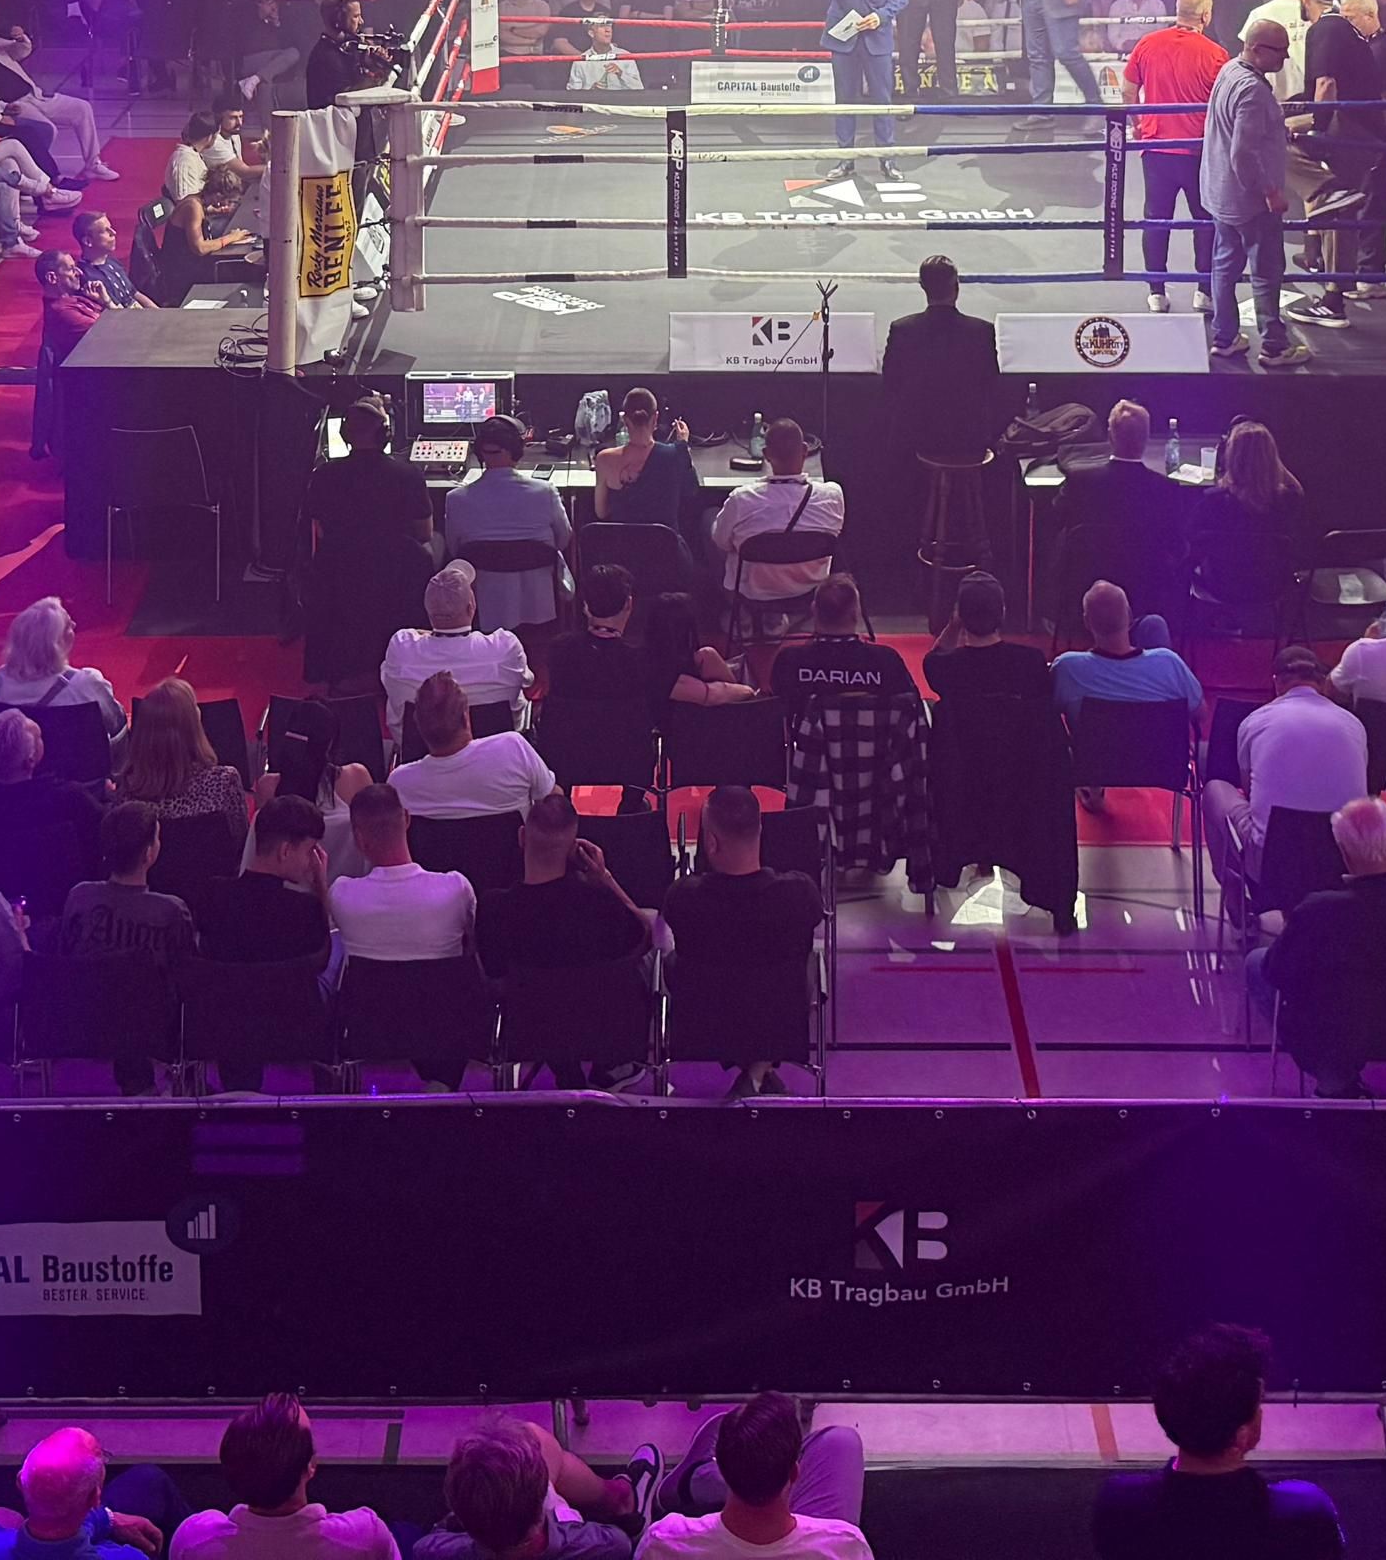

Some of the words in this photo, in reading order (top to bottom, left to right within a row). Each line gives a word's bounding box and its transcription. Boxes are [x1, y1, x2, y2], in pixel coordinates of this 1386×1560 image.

[717, 81, 757, 92] CAPITAL
[760, 81, 800, 92] Baustoffe
[671, 129, 683, 171] KBP
[1110, 121, 1123, 162] KBP
[696, 211, 746, 222] KB
[755, 210, 906, 223] Tragbau
[918, 207, 1037, 221] GmbH
[324, 180, 345, 288] BENLEE
[307, 250, 326, 288] Rocky
[725, 356, 740, 365] KB
[744, 356, 782, 368] Tragbau
[786, 356, 818, 365] GmbH
[799, 668, 881, 685] DARIAN
[42, 1254, 174, 1283] Baustoffe
[789, 1277, 823, 1299] KB
[830, 1280, 927, 1308] Tragbau
[936, 1276, 1009, 1299] GmbH
